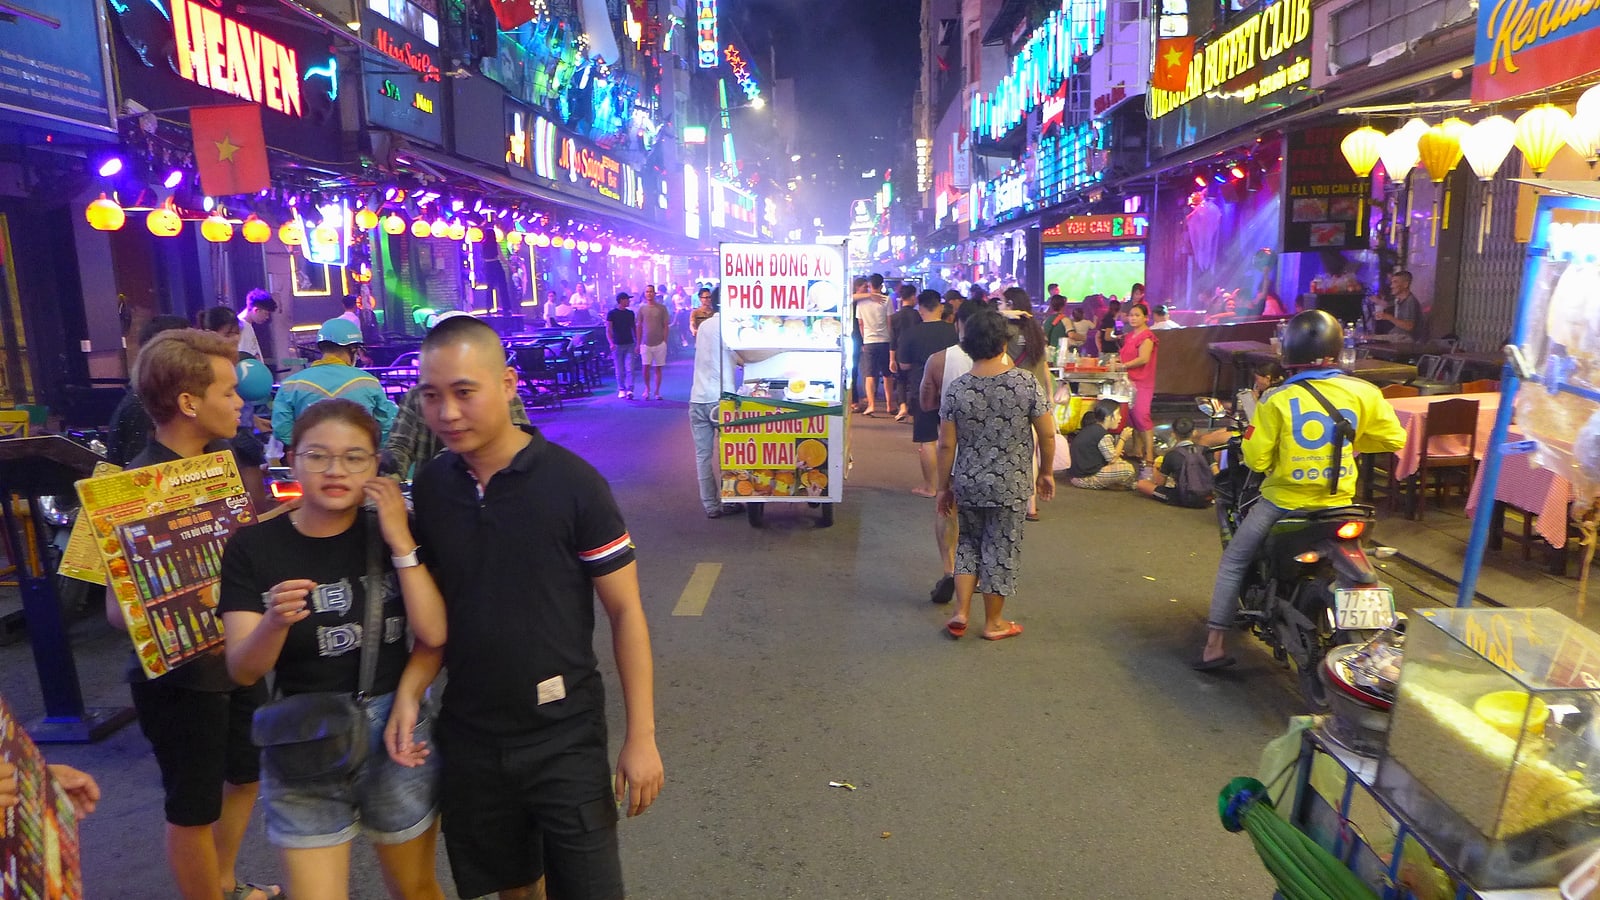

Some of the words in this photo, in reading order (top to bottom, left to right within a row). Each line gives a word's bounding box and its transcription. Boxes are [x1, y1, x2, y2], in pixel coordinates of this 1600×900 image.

[171, 0, 302, 117] HEAVEN
[1203, 14, 1260, 93] BUFFET
[1260, 0, 1311, 61] CLUB
[1290, 186, 1309, 196] ALL
[1311, 185, 1329, 195] YOU
[1332, 183, 1350, 193] CAN
[1066, 221, 1087, 234] YOU
[1089, 220, 1111, 233] CAN
[1112, 216, 1150, 237] EAT
[727, 280, 764, 309] PHÔ
[770, 285, 805, 309] MAI
[724, 438, 757, 465] PHÔ
[763, 443, 794, 465] MAI
